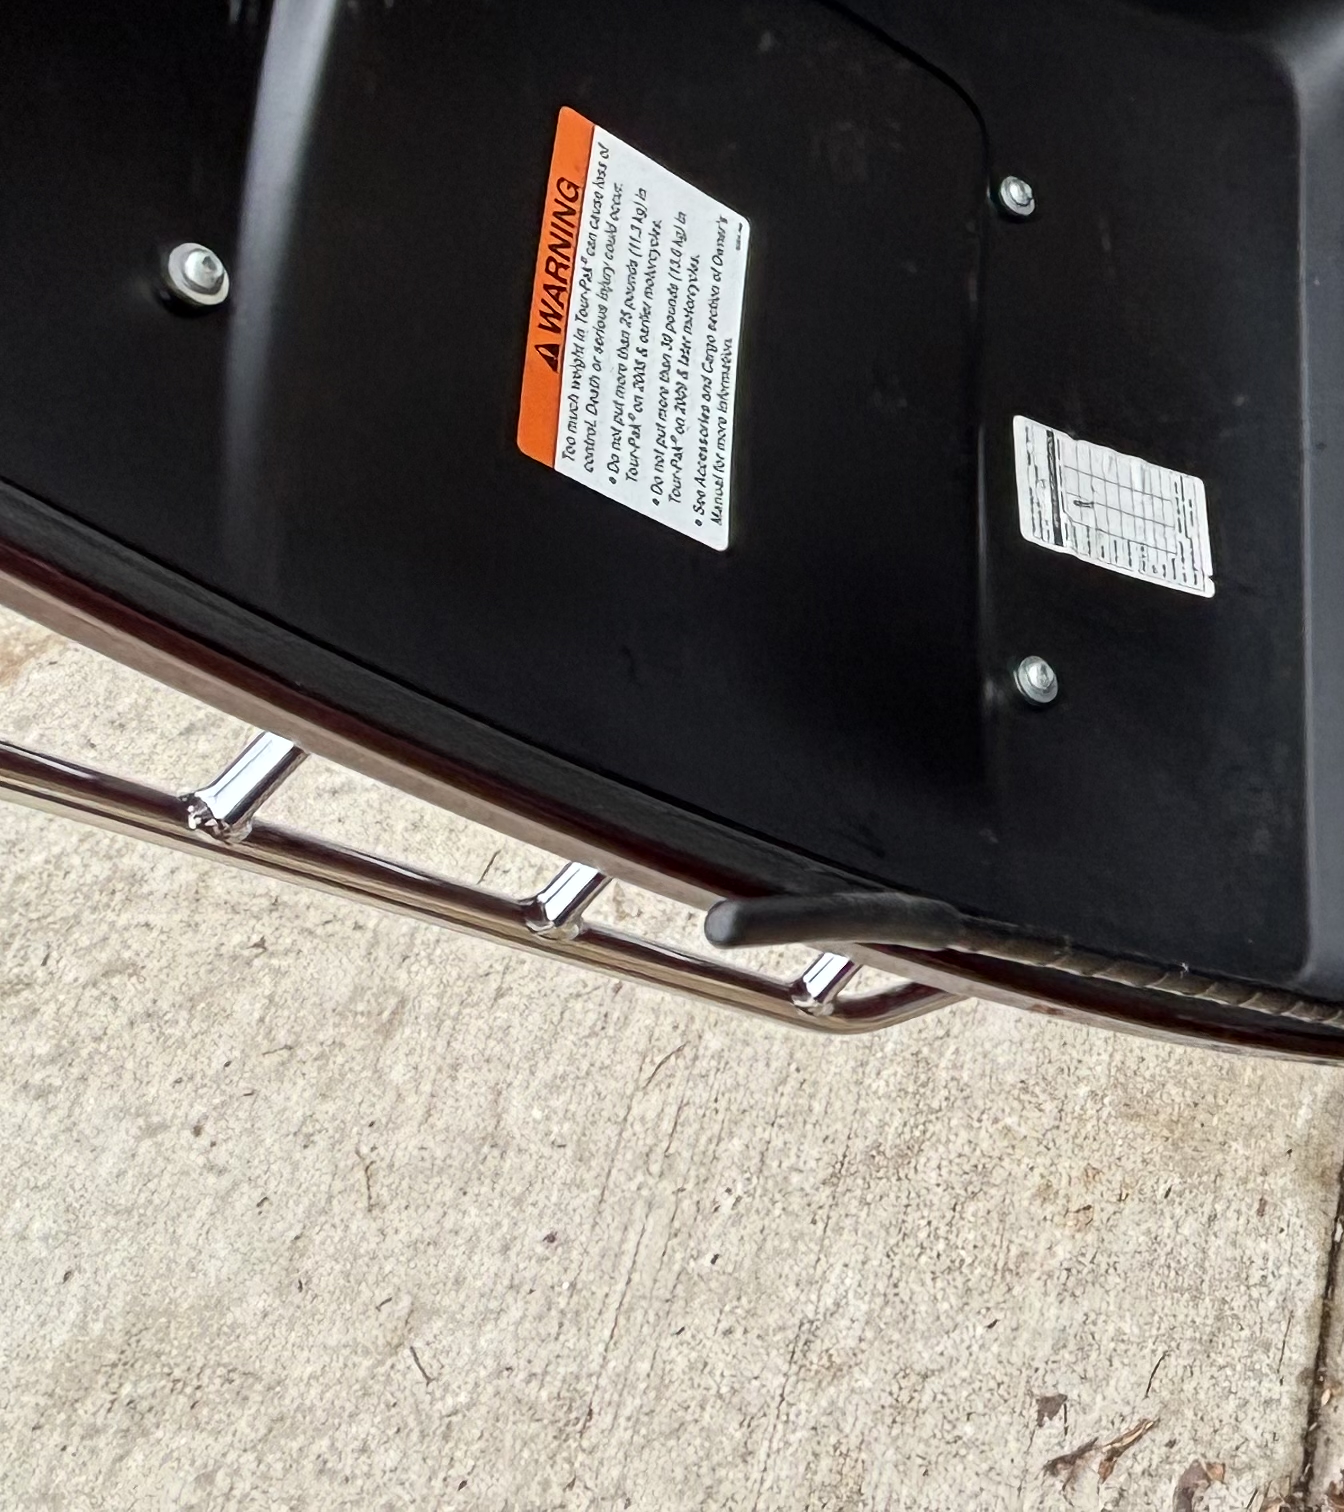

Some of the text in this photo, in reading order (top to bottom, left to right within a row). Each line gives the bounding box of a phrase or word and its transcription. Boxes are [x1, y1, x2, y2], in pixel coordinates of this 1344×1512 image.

[592, 161, 608, 190] loss
[589, 190, 604, 230] cause
[631, 201, 648, 224] kg)
[586, 232, 598, 257] can
[604, 220, 618, 261] could
[671, 224, 688, 248] kg)
[711, 215, 728, 267] Owner's
[537, 177, 580, 334] WARNING
[595, 261, 616, 302] injury
[624, 258, 639, 311] pounds
[638, 300, 652, 344] earlier
[665, 282, 679, 335] pounds
[707, 285, 720, 332] section
[592, 303, 608, 355] serious
[616, 329, 631, 360] than
[569, 342, 586, 390] weight
[659, 353, 672, 384] than
[677, 335, 692, 367] later
[701, 334, 718, 374] Cargo
[585, 374, 601, 416] Death
[615, 362, 628, 400] more
[700, 374, 713, 403] and
[567, 393, 580, 434] much
[612, 400, 625, 427] put
[658, 385, 670, 422] more
[561, 436, 577, 462] Too
[610, 425, 623, 452] not
[655, 422, 668, 449] put
[693, 404, 711, 489] Accessories
[717, 416, 728, 451] more
[653, 448, 665, 473] not
[712, 452, 725, 473] for
[692, 489, 706, 516] See
[710, 473, 724, 526] Manual
